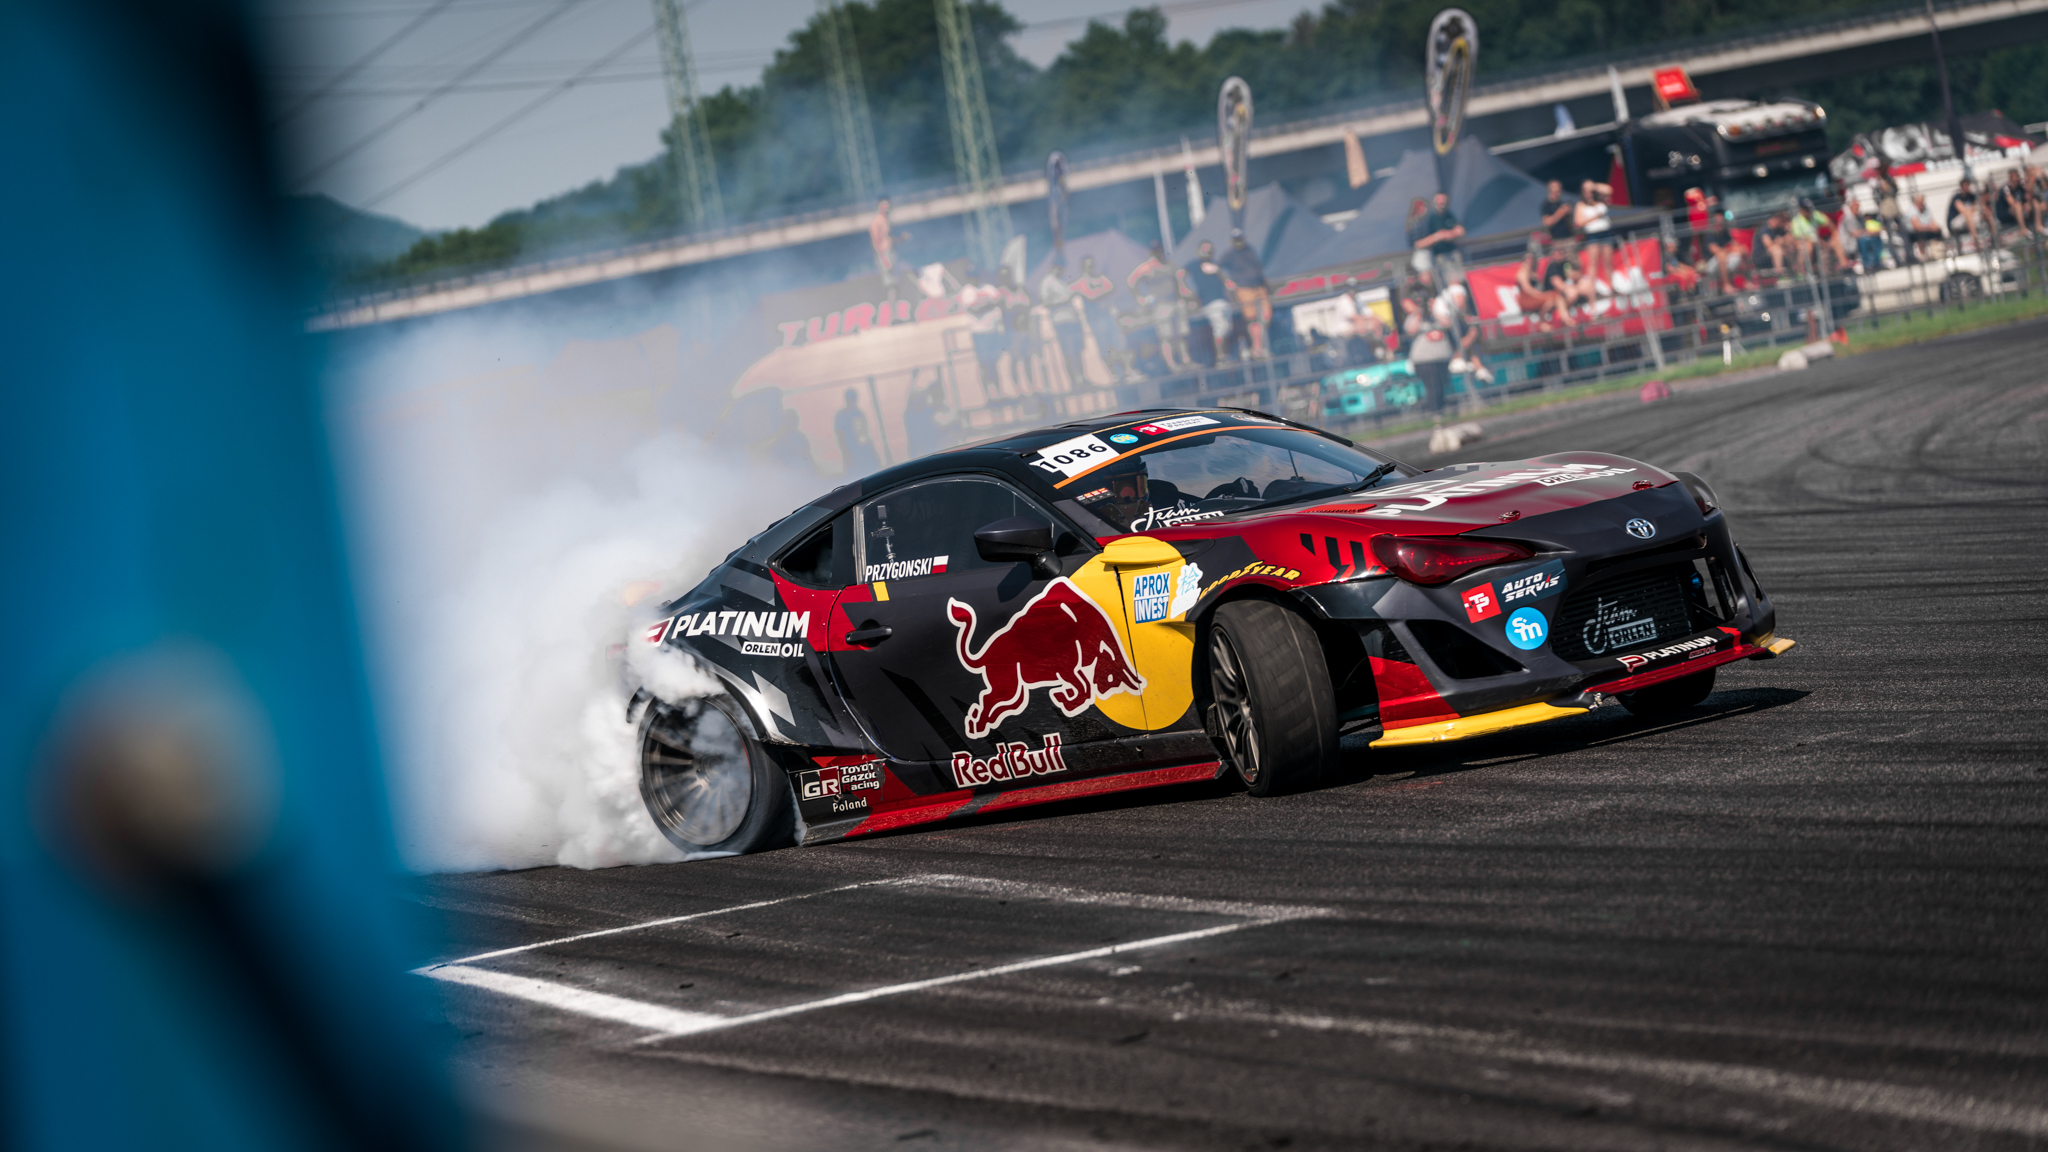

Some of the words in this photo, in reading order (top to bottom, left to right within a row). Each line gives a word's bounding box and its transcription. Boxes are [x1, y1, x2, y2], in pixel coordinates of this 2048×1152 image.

[1040, 443, 1107, 470] 1086
[1589, 467, 1638, 477] OIL
[864, 557, 932, 583] PRZYGONSKI
[1199, 560, 1302, 601] GOODYEAR
[1134, 573, 1170, 598] APROX
[1502, 572, 1543, 594] AUTO
[1135, 597, 1169, 621] INVEST
[671, 611, 810, 640] PLATINUM
[1611, 623, 1655, 644] ORLEN
[744, 643, 778, 655] ORLEN
[781, 643, 805, 657] OIL
[1641, 635, 1719, 661] PLATINUM
[840, 762, 874, 775] TOYOT
[952, 742, 1013, 789] Red
[1007, 732, 1068, 779] Bull
[804, 778, 840, 798] GR
[842, 780, 880, 793] Racing
[832, 797, 868, 812] Poland
